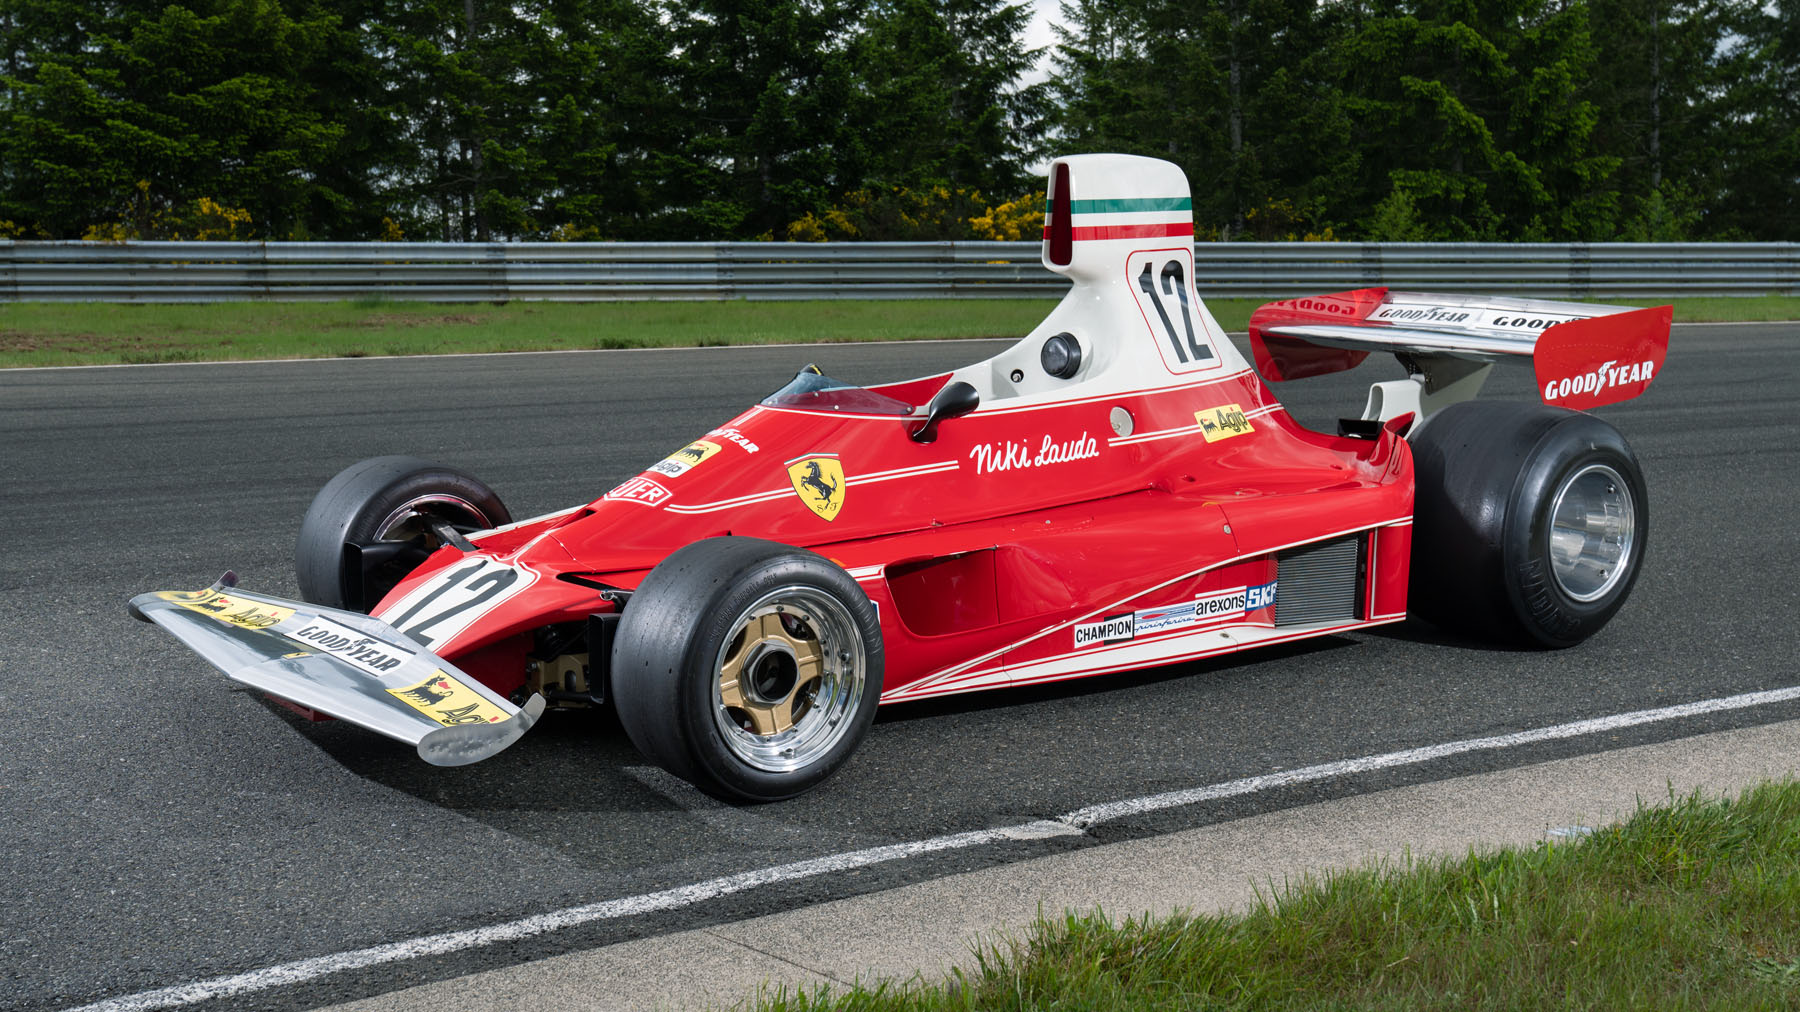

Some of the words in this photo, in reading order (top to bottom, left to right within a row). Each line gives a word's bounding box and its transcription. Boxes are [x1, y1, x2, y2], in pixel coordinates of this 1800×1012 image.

[1138, 260, 1214, 364] 12
[1378, 307, 1471, 323] GOODYEAR
[1492, 316, 1583, 329] GOOD
[1545, 360, 1655, 401] GOODYEAR
[1215, 407, 1248, 433] Agip
[705, 429, 760, 454] YEAR
[969, 438, 1032, 475] Niki
[1034, 432, 1100, 467] Lauda
[656, 461, 682, 473] gip
[609, 479, 665, 502] UER
[390, 559, 519, 648] 12
[1196, 594, 1245, 616] arexons
[1246, 582, 1278, 609] SKF
[1076, 619, 1132, 643] CHAMPION
[297, 626, 402, 672] GOODYEAR
